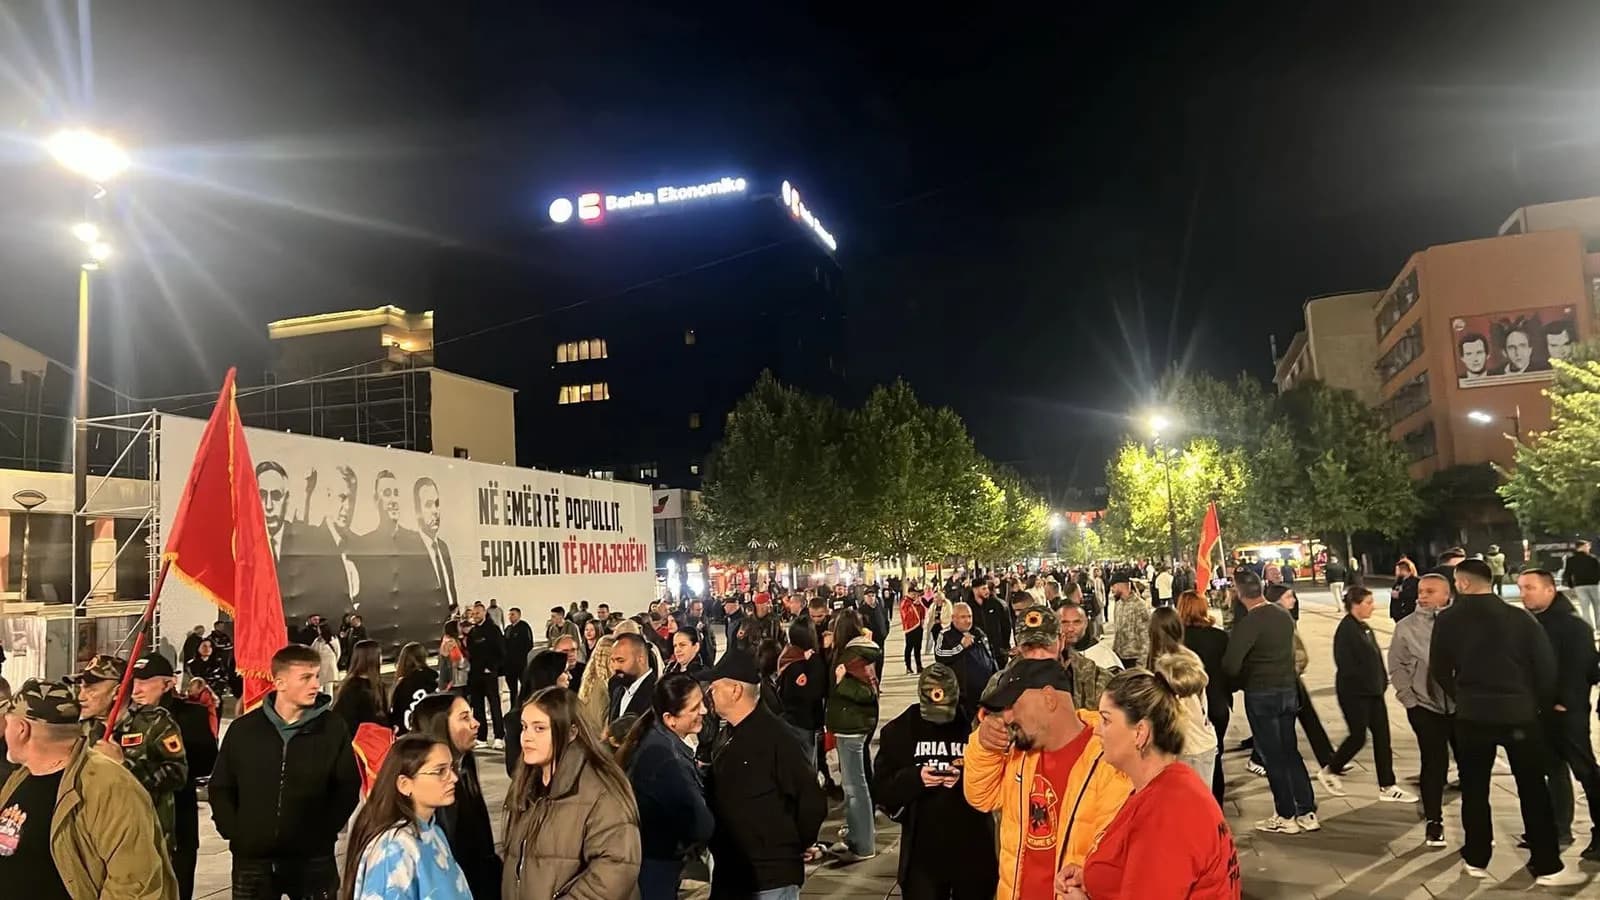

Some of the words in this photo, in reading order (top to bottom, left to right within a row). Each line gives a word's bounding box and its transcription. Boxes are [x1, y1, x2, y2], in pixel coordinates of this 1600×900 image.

[605, 191, 655, 211] Banka
[657, 177, 746, 203] Ekonomike
[478, 480, 499, 525] NË
[503, 484, 542, 527] EMËR
[544, 487, 560, 528] TË
[565, 496, 624, 534] POPULLIT,
[480, 540, 560, 577] SHPALLENI
[563, 534, 578, 574] TË
[580, 537, 647, 574] PAFAJSHËM!
